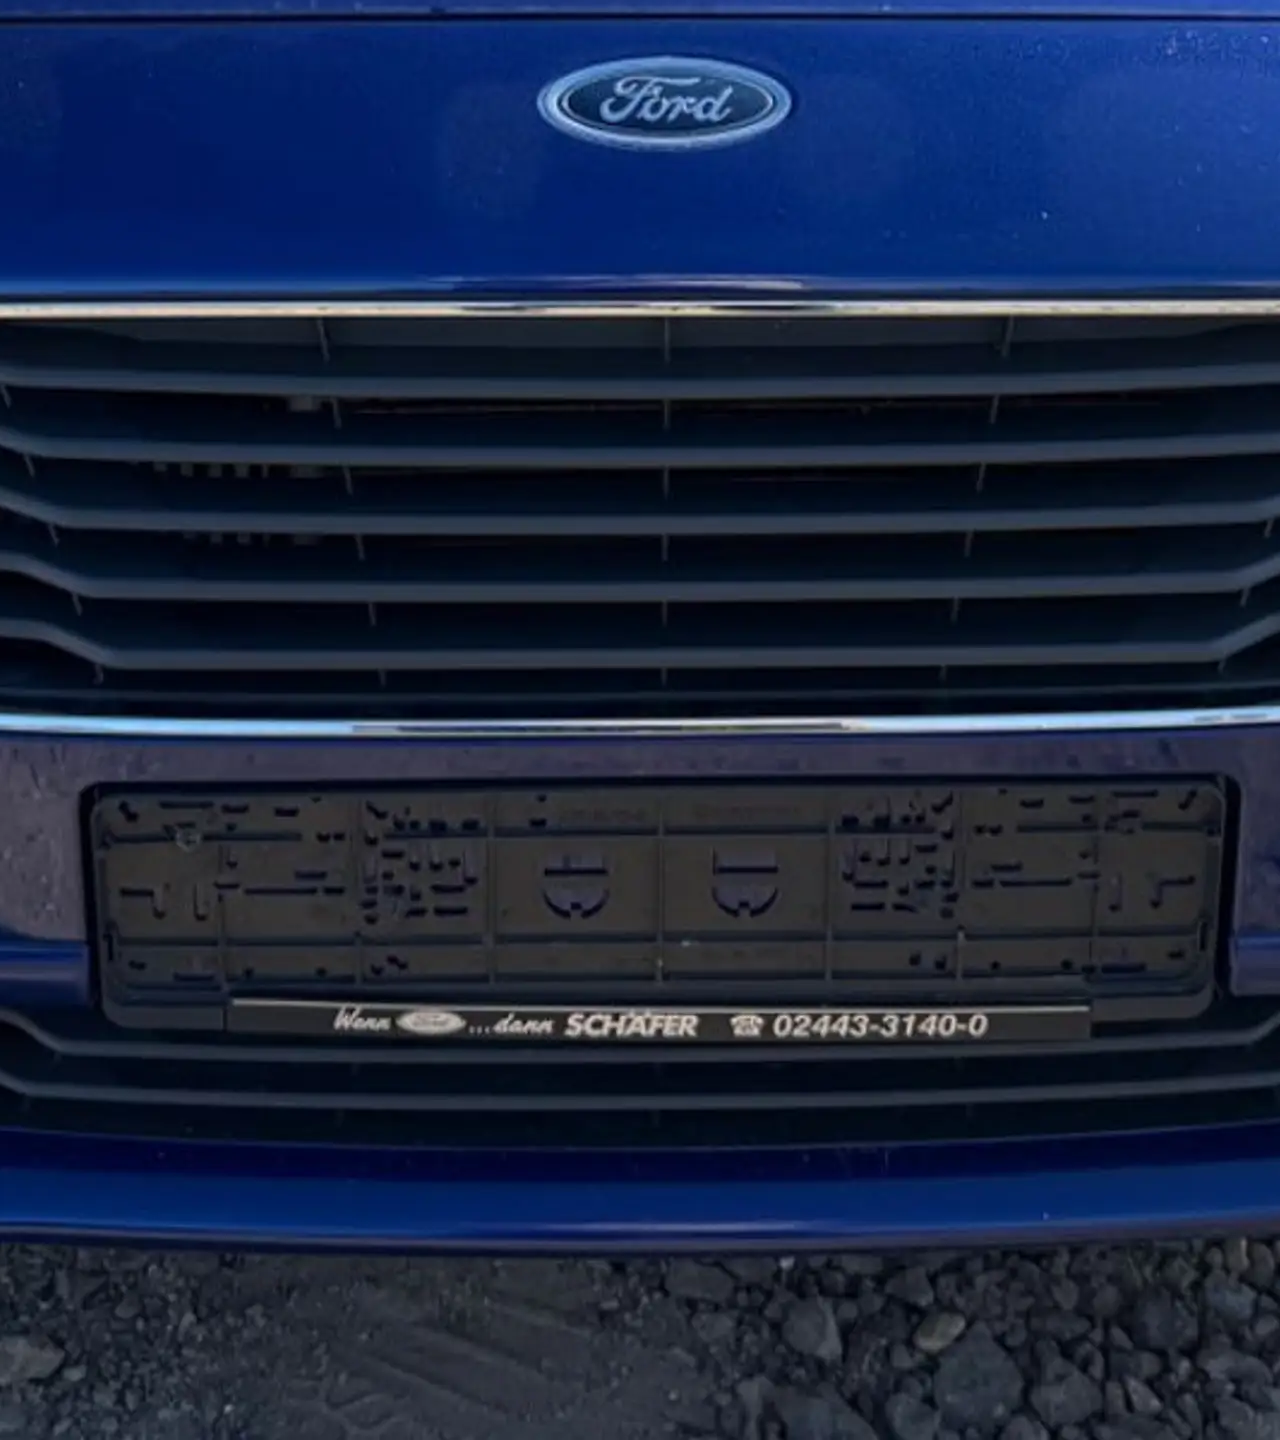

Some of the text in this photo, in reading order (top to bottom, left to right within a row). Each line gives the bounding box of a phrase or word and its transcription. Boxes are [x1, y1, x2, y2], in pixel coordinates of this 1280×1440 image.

[599, 75, 734, 123] Ford
[333, 1005, 392, 1031] Wenn
[565, 1010, 700, 1037] SCHÄFER
[772, 1013, 989, 1038] 02443-3140-0
